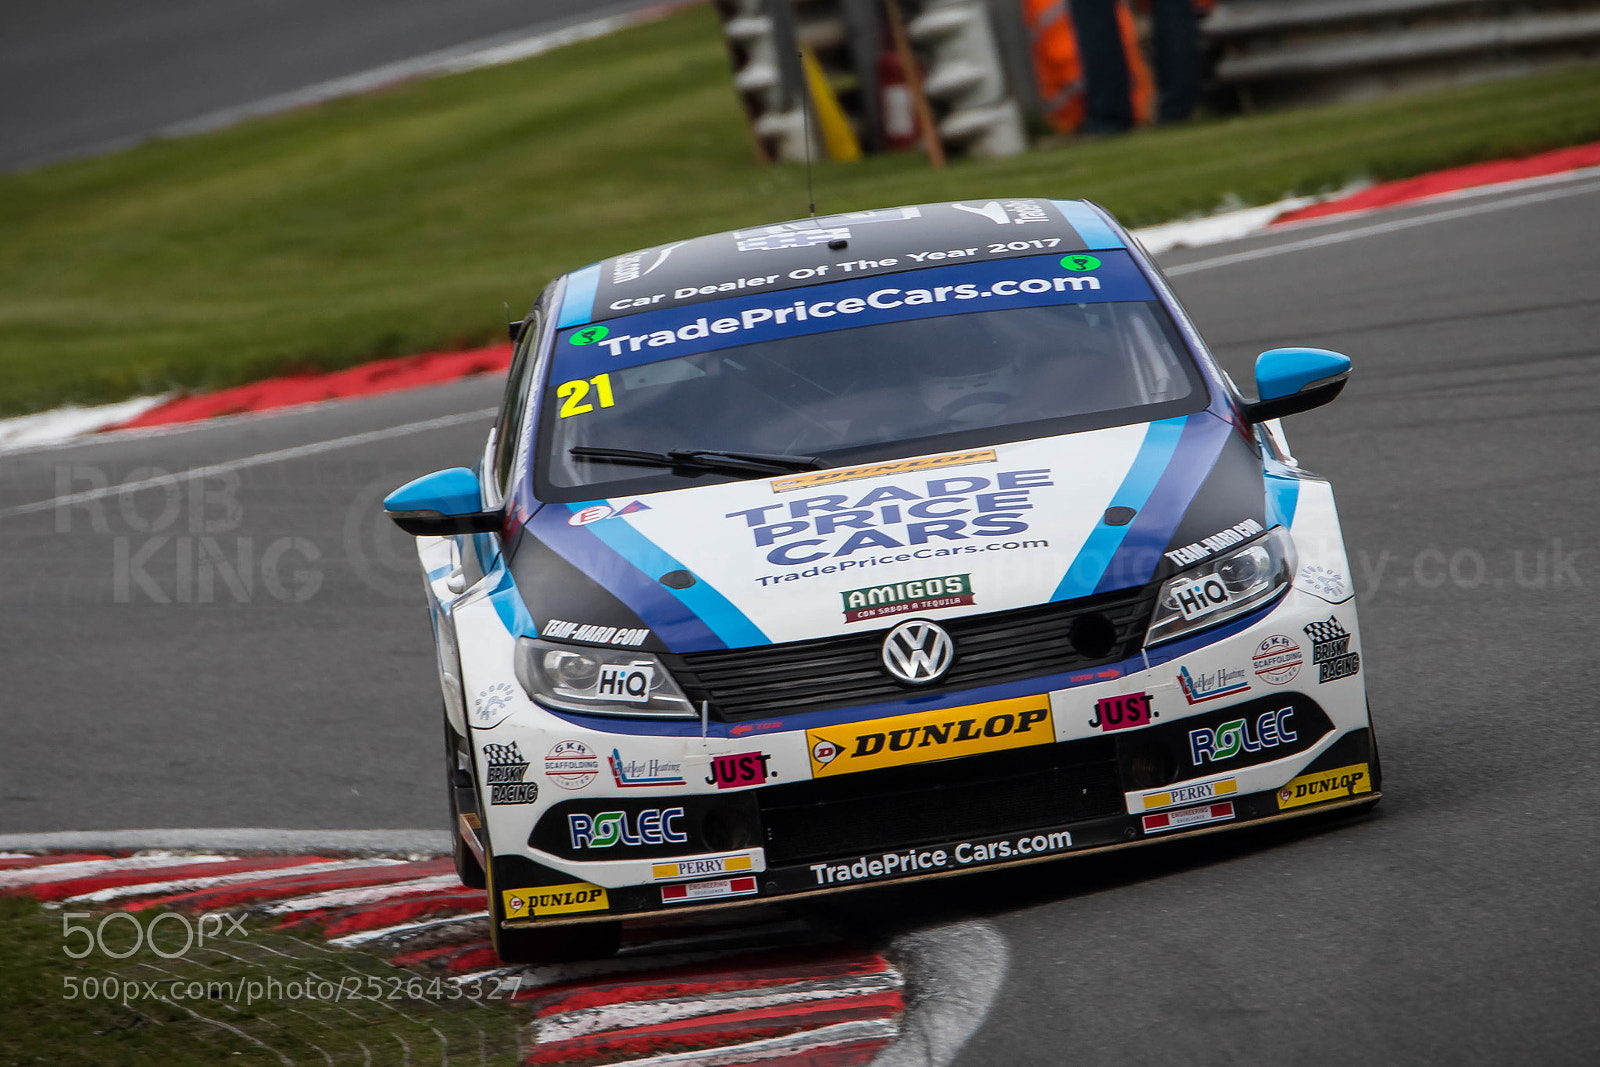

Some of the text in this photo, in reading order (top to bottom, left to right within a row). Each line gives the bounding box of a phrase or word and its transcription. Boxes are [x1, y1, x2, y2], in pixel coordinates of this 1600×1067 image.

[609, 238, 1062, 310] Car Dealer Of The Year 2017
[598, 276, 1101, 356] TradePriceCars.com
[556, 373, 615, 419] 21
[810, 452, 994, 481] DUNLOP
[725, 469, 1055, 528] TRADE
[753, 489, 1034, 547] PRICE
[766, 512, 1030, 566] CARS
[755, 538, 1049, 587] TradePriceCars.com
[848, 576, 964, 609] AMIGOS
[1177, 580, 1228, 615] HiQ
[857, 610, 876, 618] CON
[878, 604, 909, 615] SABOR
[921, 597, 961, 608] TEQUILA
[541, 619, 650, 647] TEAM-HARD.COM
[1261, 637, 1290, 651] GKR
[1253, 652, 1302, 669] SCAFFOLDING
[1320, 654, 1360, 681] RACING
[599, 671, 647, 698] HiQ
[850, 708, 1048, 758] DUNLOP
[1188, 706, 1297, 766] ROLEC
[555, 742, 586, 754] GKR
[544, 761, 598, 770] SCAFFOLDING
[493, 784, 538, 803] RACING
[1170, 784, 1214, 804] PERRY
[1295, 772, 1364, 798] DUNLOP
[568, 807, 687, 849] ROLEC
[679, 859, 724, 875] PERRY
[810, 830, 1073, 885] TradePrice Cars.com
[527, 889, 602, 908] DUNLOP
